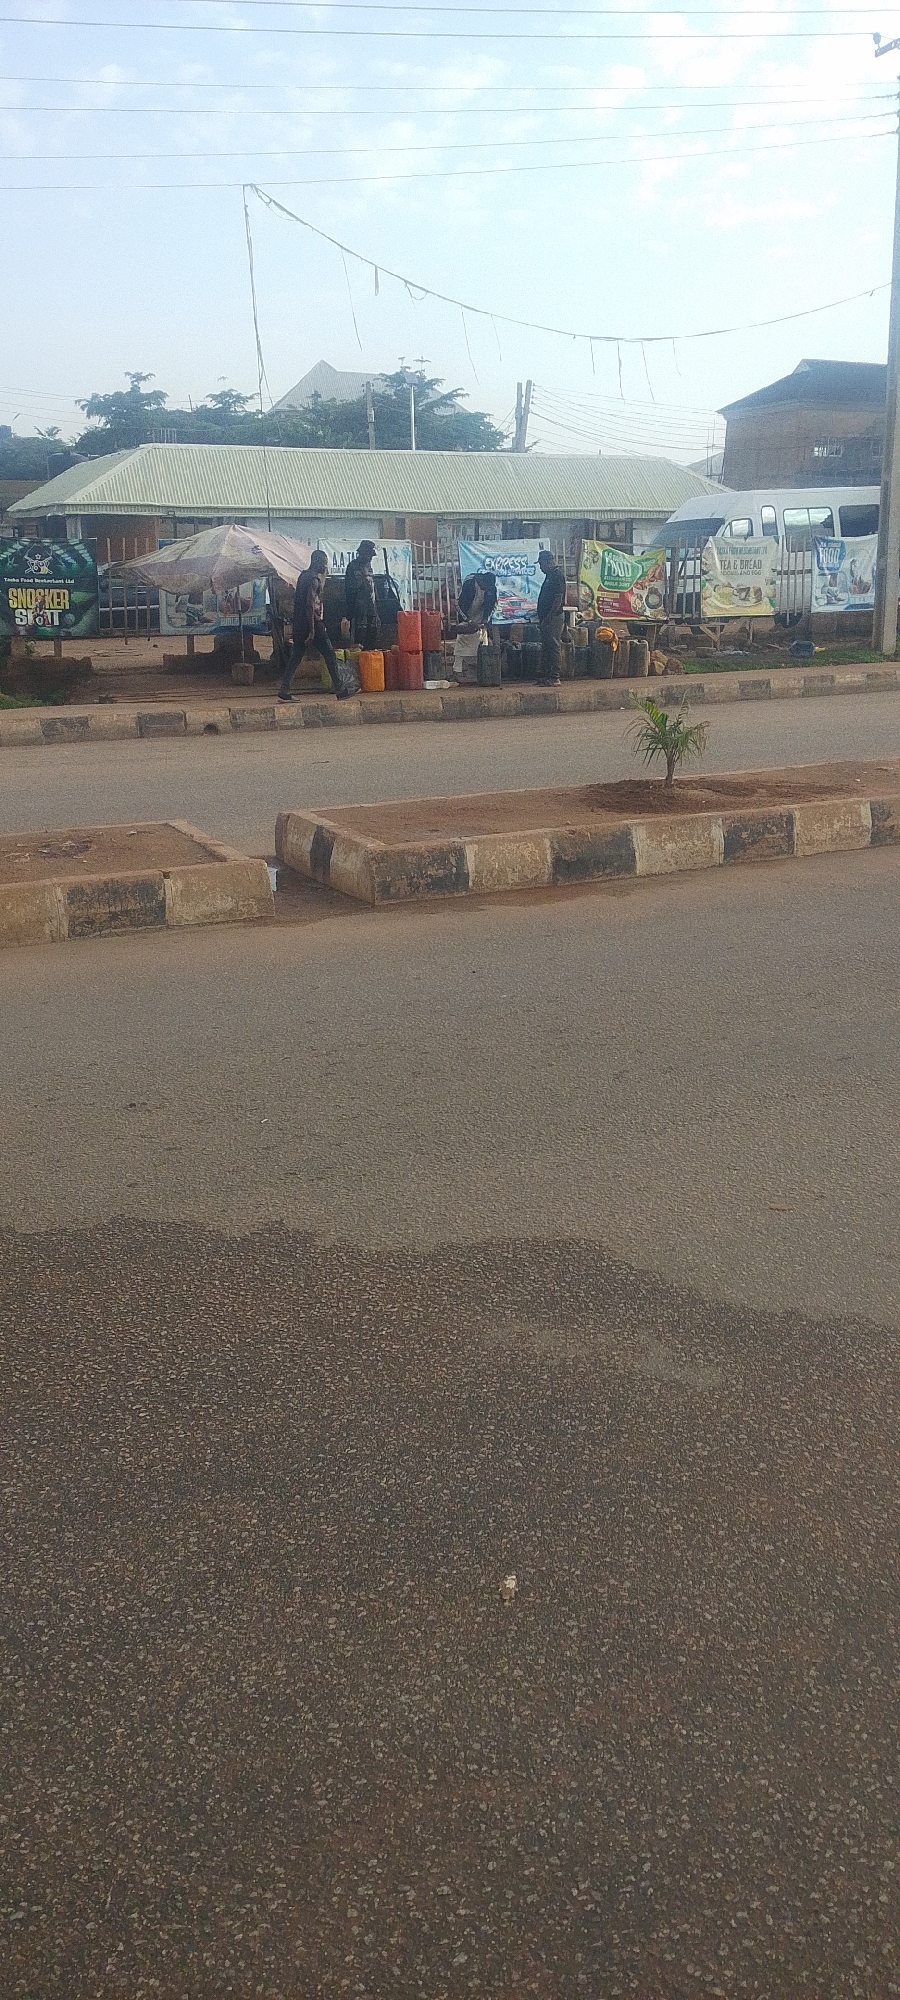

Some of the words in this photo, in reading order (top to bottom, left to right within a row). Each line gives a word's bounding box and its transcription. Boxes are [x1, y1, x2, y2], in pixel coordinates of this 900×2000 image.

[484, 556, 528, 571] EXPRESS
[819, 547, 840, 564] FOOD
[605, 557, 632, 577] FOOD
[720, 559, 732, 570] TEA
[733, 559, 739, 570] &
[740, 559, 762, 570] BREAD
